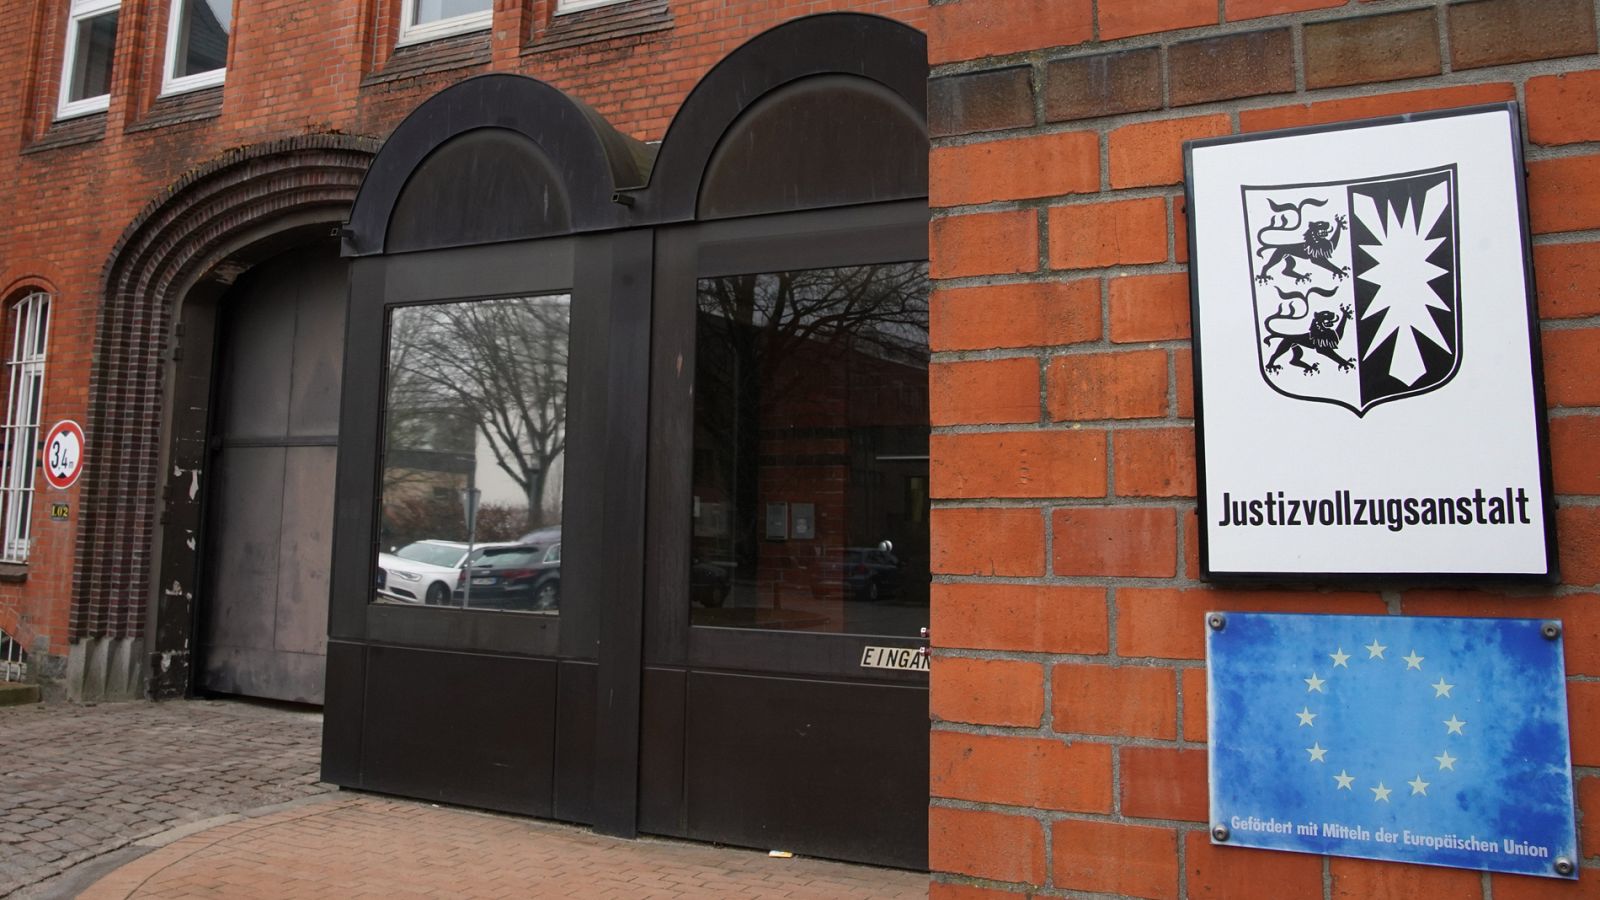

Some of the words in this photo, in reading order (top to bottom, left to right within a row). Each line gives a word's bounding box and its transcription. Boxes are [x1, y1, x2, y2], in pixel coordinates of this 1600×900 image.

[1218, 487, 1531, 531] Justizvollzugsanstalt
[1231, 815, 1293, 834] Gefördert
[1297, 822, 1318, 836] mit
[1322, 823, 1371, 841] Mitteln
[1375, 827, 1398, 843] der
[1403, 830, 1499, 852] Europäischen
[1503, 838, 1549, 857] Union
